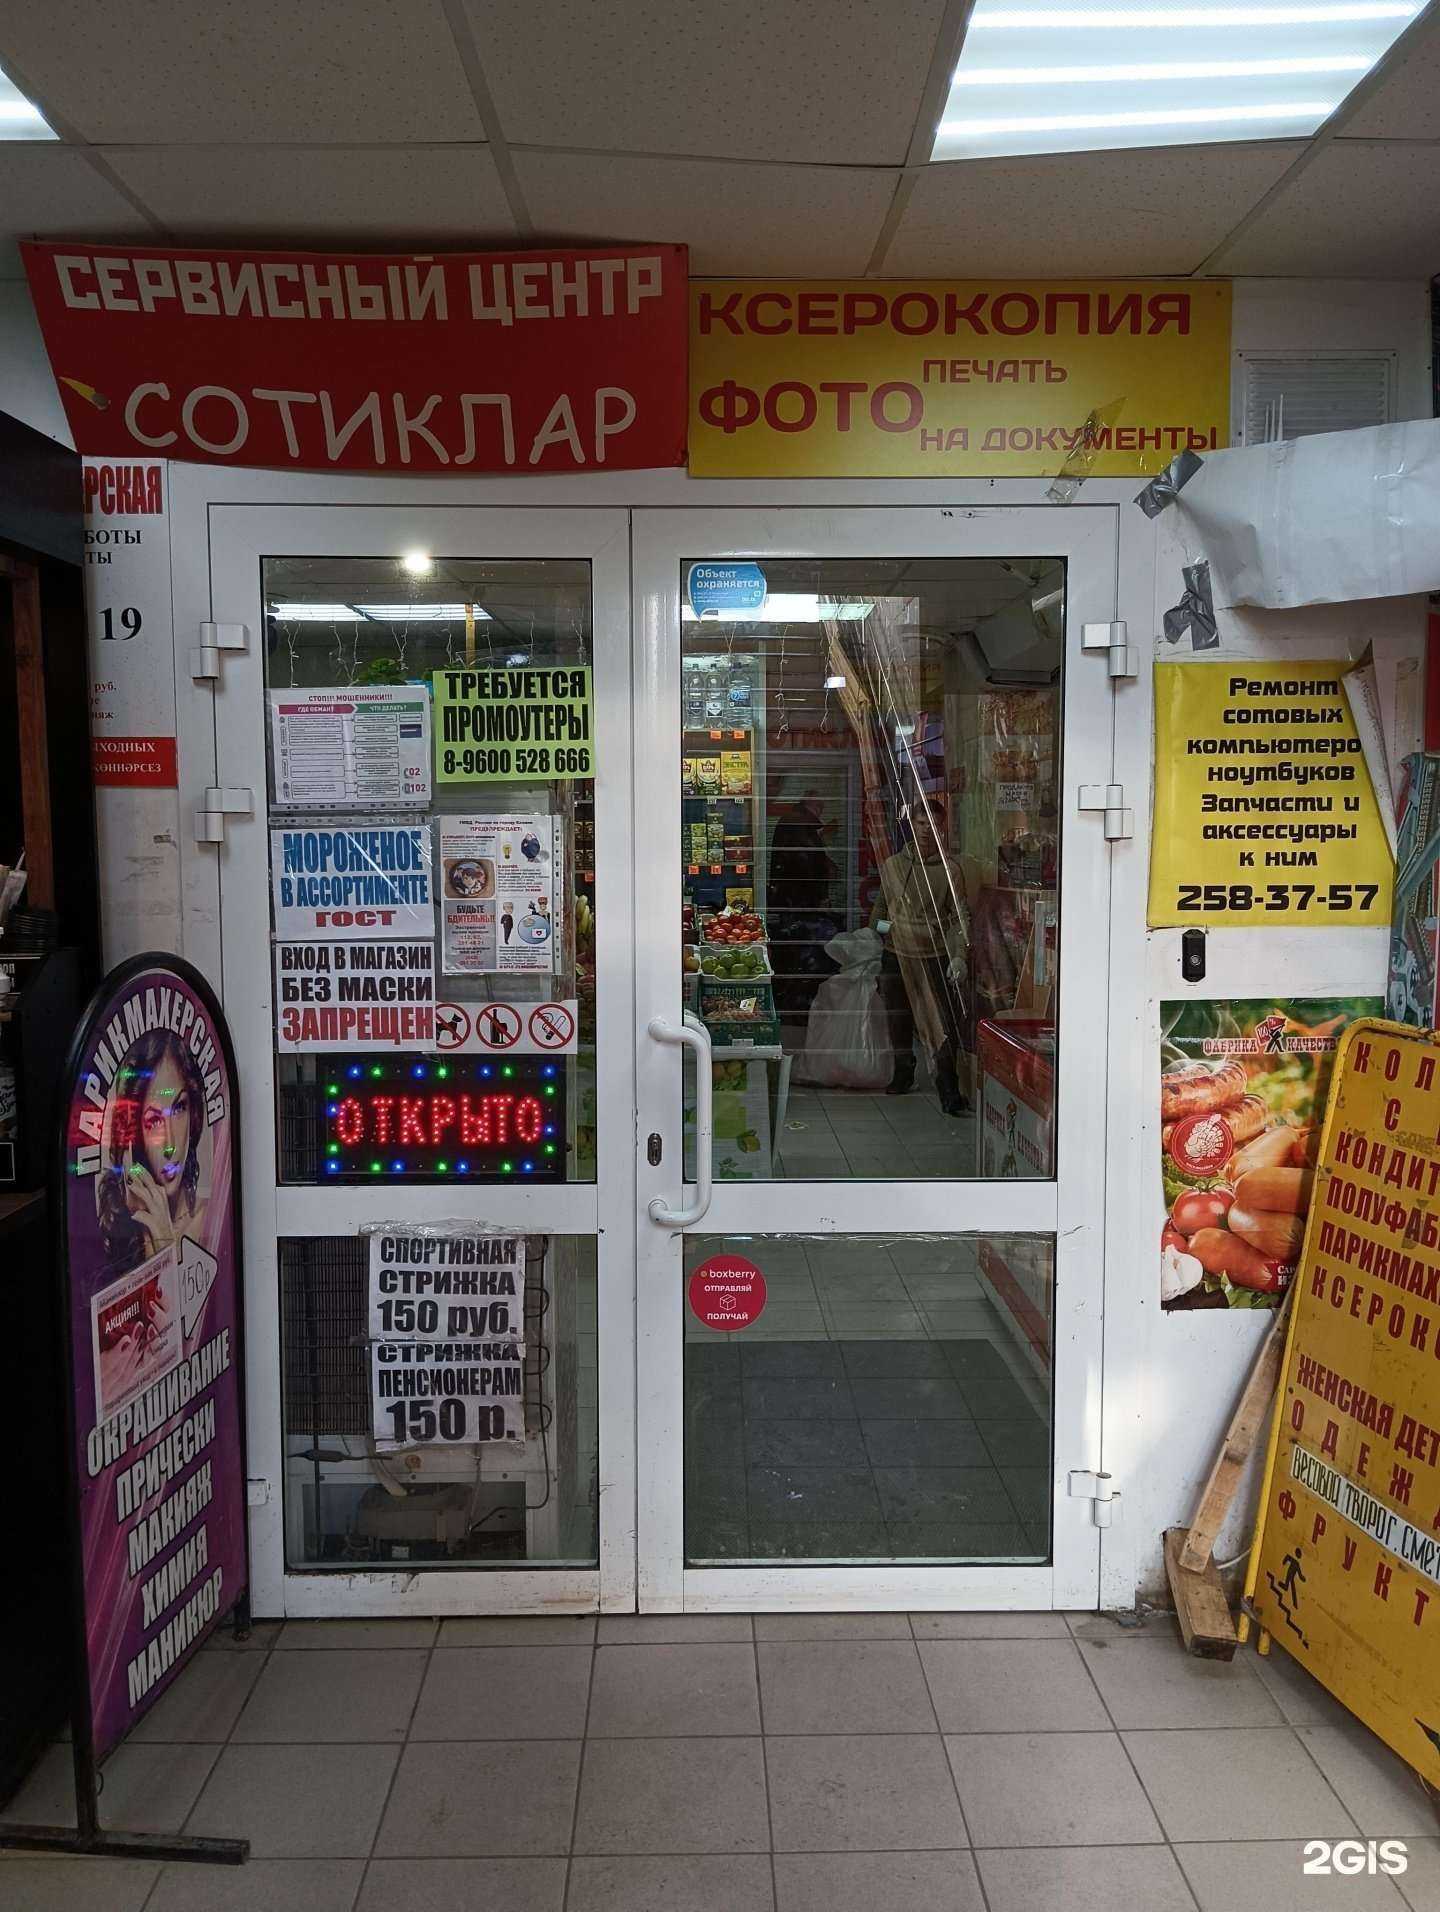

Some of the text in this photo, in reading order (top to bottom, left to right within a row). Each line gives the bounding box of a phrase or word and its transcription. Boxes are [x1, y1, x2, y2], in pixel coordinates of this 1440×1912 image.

[54, 255, 662, 326] СЕРВИСНЫЙ ЦЕНТР
[701, 292, 1191, 335] КСЕРОКОПИЯ
[923, 359, 1068, 384] ПЕЧАТЬ
[699, 380, 924, 433] ФОТО
[124, 382, 636, 464] СОТИКЛАР
[920, 427, 1217, 451] НА ДОКУМЕНТЫ
[82, 465, 163, 515] РСКАЯ
[697, 569, 737, 578] Объект
[697, 580, 760, 590] охраняется
[99, 607, 142, 641] 19
[445, 671, 586, 699] ТРЕБУЕТСЯ
[1229, 677, 1338, 696] Ремонт
[443, 704, 589, 742] ПРОМОУТЕРЫ
[1223, 708, 1343, 724] сотовых
[444, 748, 590, 774] 8-9600 528 666
[1207, 762, 1355, 785] ноутбуков
[1201, 794, 1360, 812] Запчасти и
[1202, 824, 1357, 843] аксессуары
[283, 831, 423, 873] МОРОЖЕНОЕ
[1239, 851, 1318, 866] к ним
[281, 875, 429, 907] В АССОРТИМЕНТЕ
[1177, 885, 1379, 911] 258-37-57
[316, 910, 397, 928] ГОСТ
[281, 947, 331, 973] ВХОД
[335, 947, 346, 970] В
[350, 946, 432, 970] МАГАЗИН
[282, 976, 432, 1002] БЕЗ МАСКИ
[283, 1006, 434, 1045] ЗАПРЕЩЕН
[1203, 1039, 1258, 1054] ФАБРИКА
[77, 986, 225, 1176] ПАРИКМАХЕРСКАЯ
[337, 1095, 542, 1145] ОТКРЫТО
[380, 1237, 517, 1265] СПОРТИВНАЯ
[379, 1269, 516, 1295] СТРИЖКА
[704, 1283, 752, 1292] ОТПРАВЛЯЙ
[710, 1269, 756, 1279] boxberry
[105, 1301, 140, 1335] АКЦИЯ!!!
[377, 1300, 518, 1337] 150 руб.
[707, 1312, 749, 1320] ПОЛУЧАЙ
[377, 1343, 521, 1363] СТРИЖКА
[378, 1367, 521, 1397] ПЕНСИОНЕРАМ
[88, 1327, 230, 1477] ОКРАШИВАНИЕ
[1297, 1354, 1394, 1440] ЖЕНСКАЯ
[386, 1398, 515, 1442] 150 р.
[116, 1398, 216, 1523] ПРИЧЕСКИ
[129, 1459, 213, 1578] МАКИЯЖ
[141, 1524, 208, 1631] ХИМИЯ
[128, 1566, 223, 1710] МАНИКЮР
